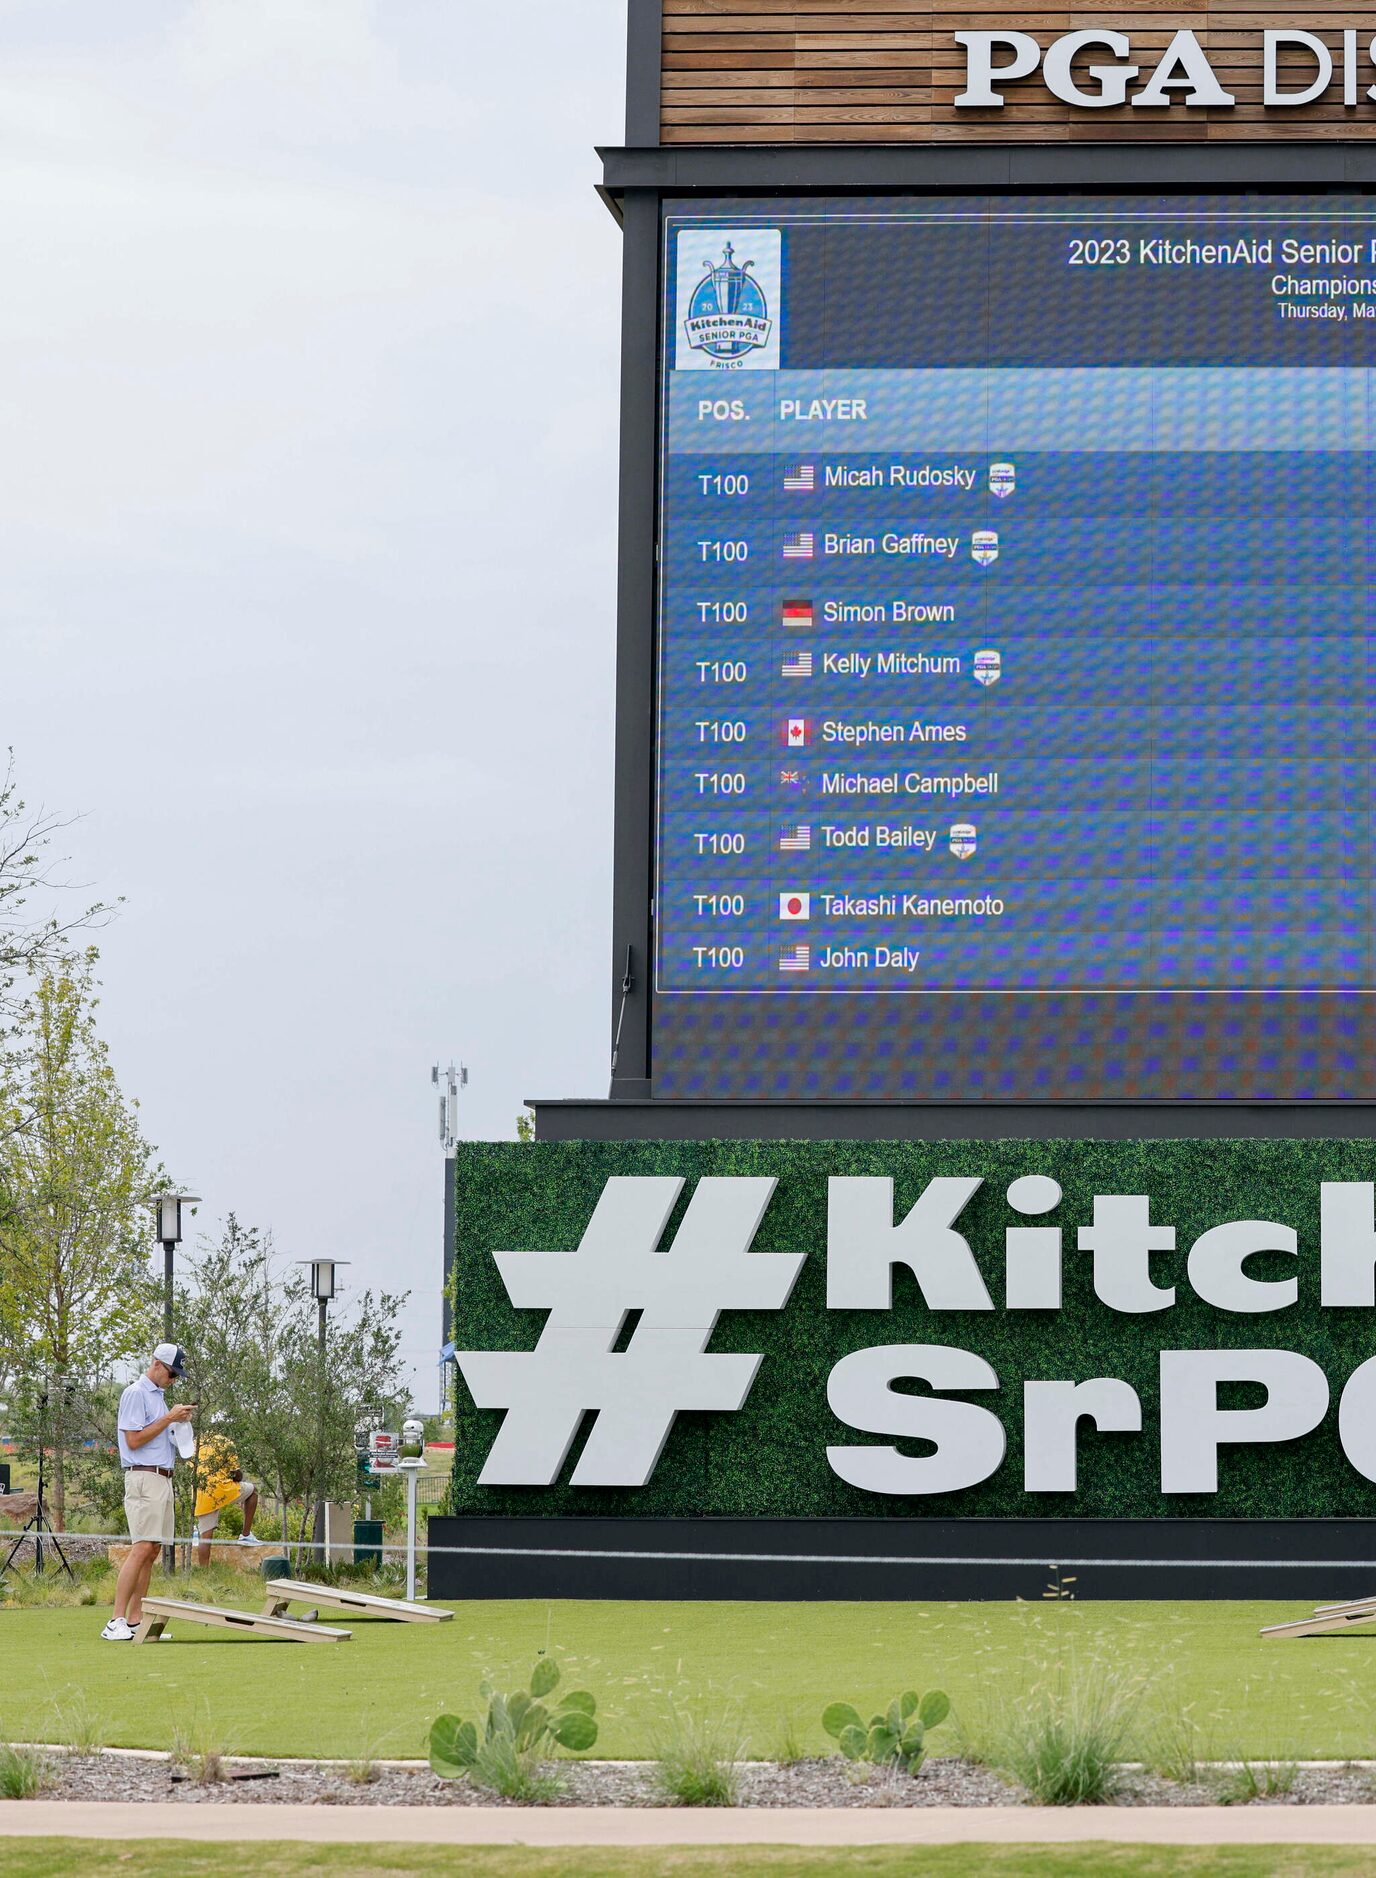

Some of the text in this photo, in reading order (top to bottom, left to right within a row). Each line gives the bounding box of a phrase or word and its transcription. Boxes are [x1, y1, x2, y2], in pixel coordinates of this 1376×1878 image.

[953, 29, 1236, 107] PGA
[1069, 240, 1131, 263] 2023
[1140, 240, 1272, 263] KitchenAid
[1282, 240, 1363, 263] Senior
[1278, 303, 1347, 321] Thursday,
[690, 318, 767, 331] KitchenAid
[699, 330, 758, 342] SENIOR PGA
[709, 360, 743, 369] FRISCO
[699, 400, 750, 420] POS.
[781, 400, 867, 419] PLAYER
[699, 475, 748, 494] T100
[825, 466, 883, 487] Micah
[891, 466, 975, 492] Rudosky
[698, 542, 747, 561] T100
[825, 534, 875, 554] Brian
[882, 534, 958, 558] Gaffney
[697, 602, 747, 622] T100
[824, 602, 954, 622] Simon Brown
[696, 662, 746, 682] T100
[824, 654, 871, 678] Kelly
[878, 653, 960, 674] Mitchum
[696, 722, 745, 741] T100
[823, 722, 966, 745] Stephen Ames
[695, 774, 745, 793] T100
[822, 773, 997, 797] Michael Campbell
[694, 834, 744, 853] T100
[822, 827, 869, 847] Todd
[876, 826, 936, 851] Bailey
[693, 895, 744, 915] T100
[821, 895, 1003, 915] Takashi Kanemoto
[693, 948, 744, 967] T100
[820, 947, 919, 971] John Daly
